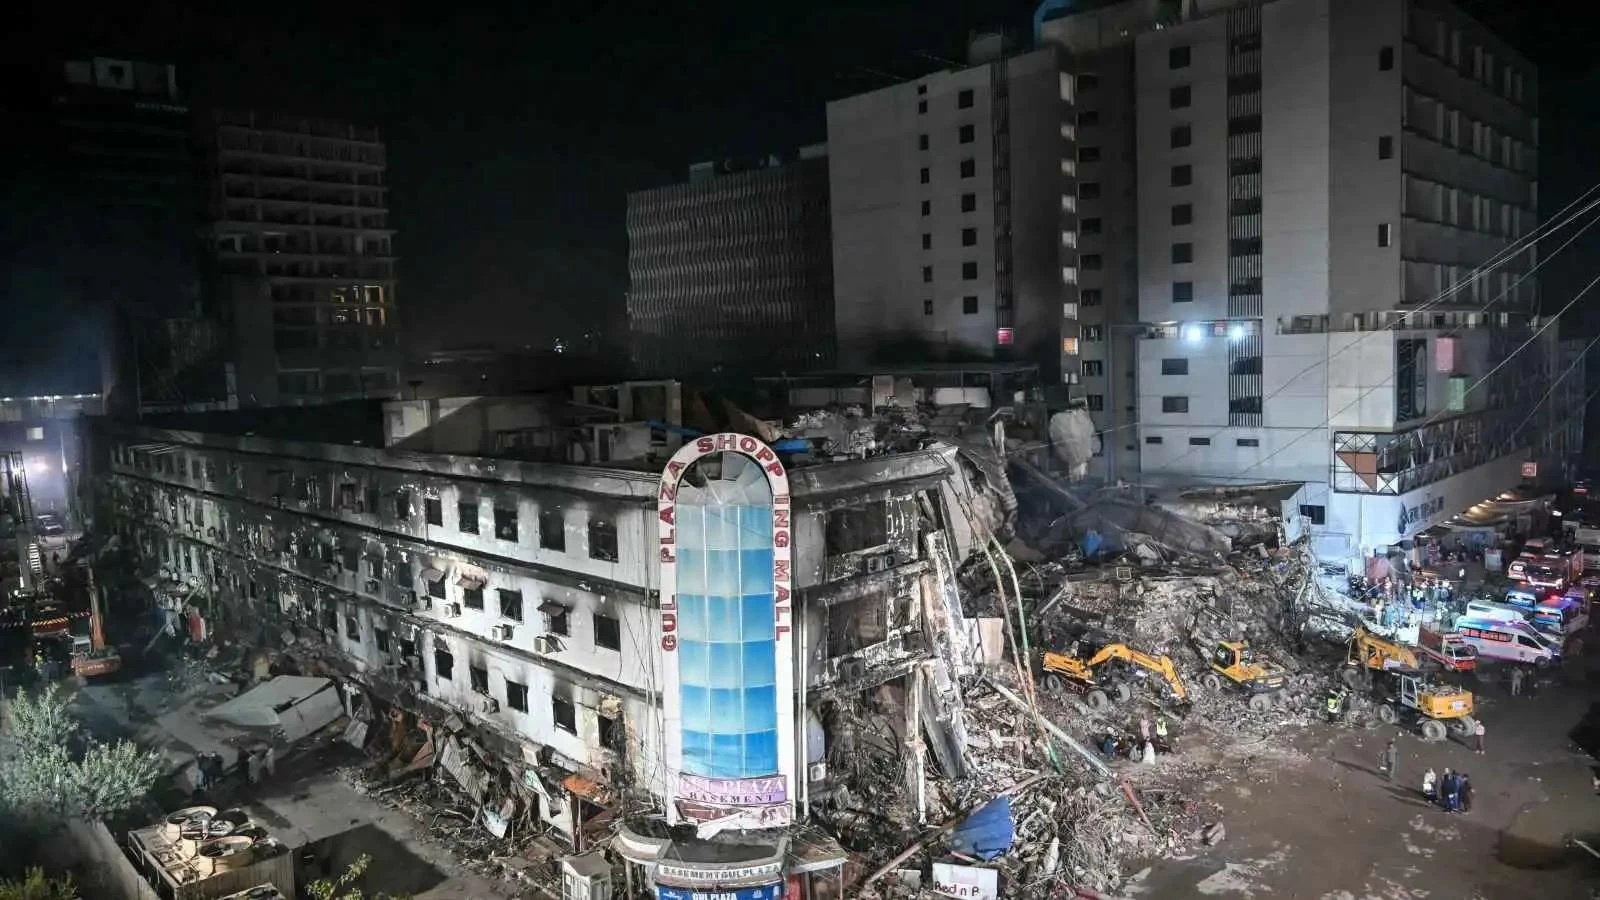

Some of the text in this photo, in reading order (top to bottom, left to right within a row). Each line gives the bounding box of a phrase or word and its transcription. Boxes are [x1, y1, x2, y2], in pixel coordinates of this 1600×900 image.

[659, 461, 686, 563] PLAZA
[662, 594, 677, 652] GUL
[774, 559, 790, 641] MALL
[689, 791, 772, 804] BASEMENT
[663, 867, 719, 879] BASEMENT
[743, 864, 781, 877] PLAZA
